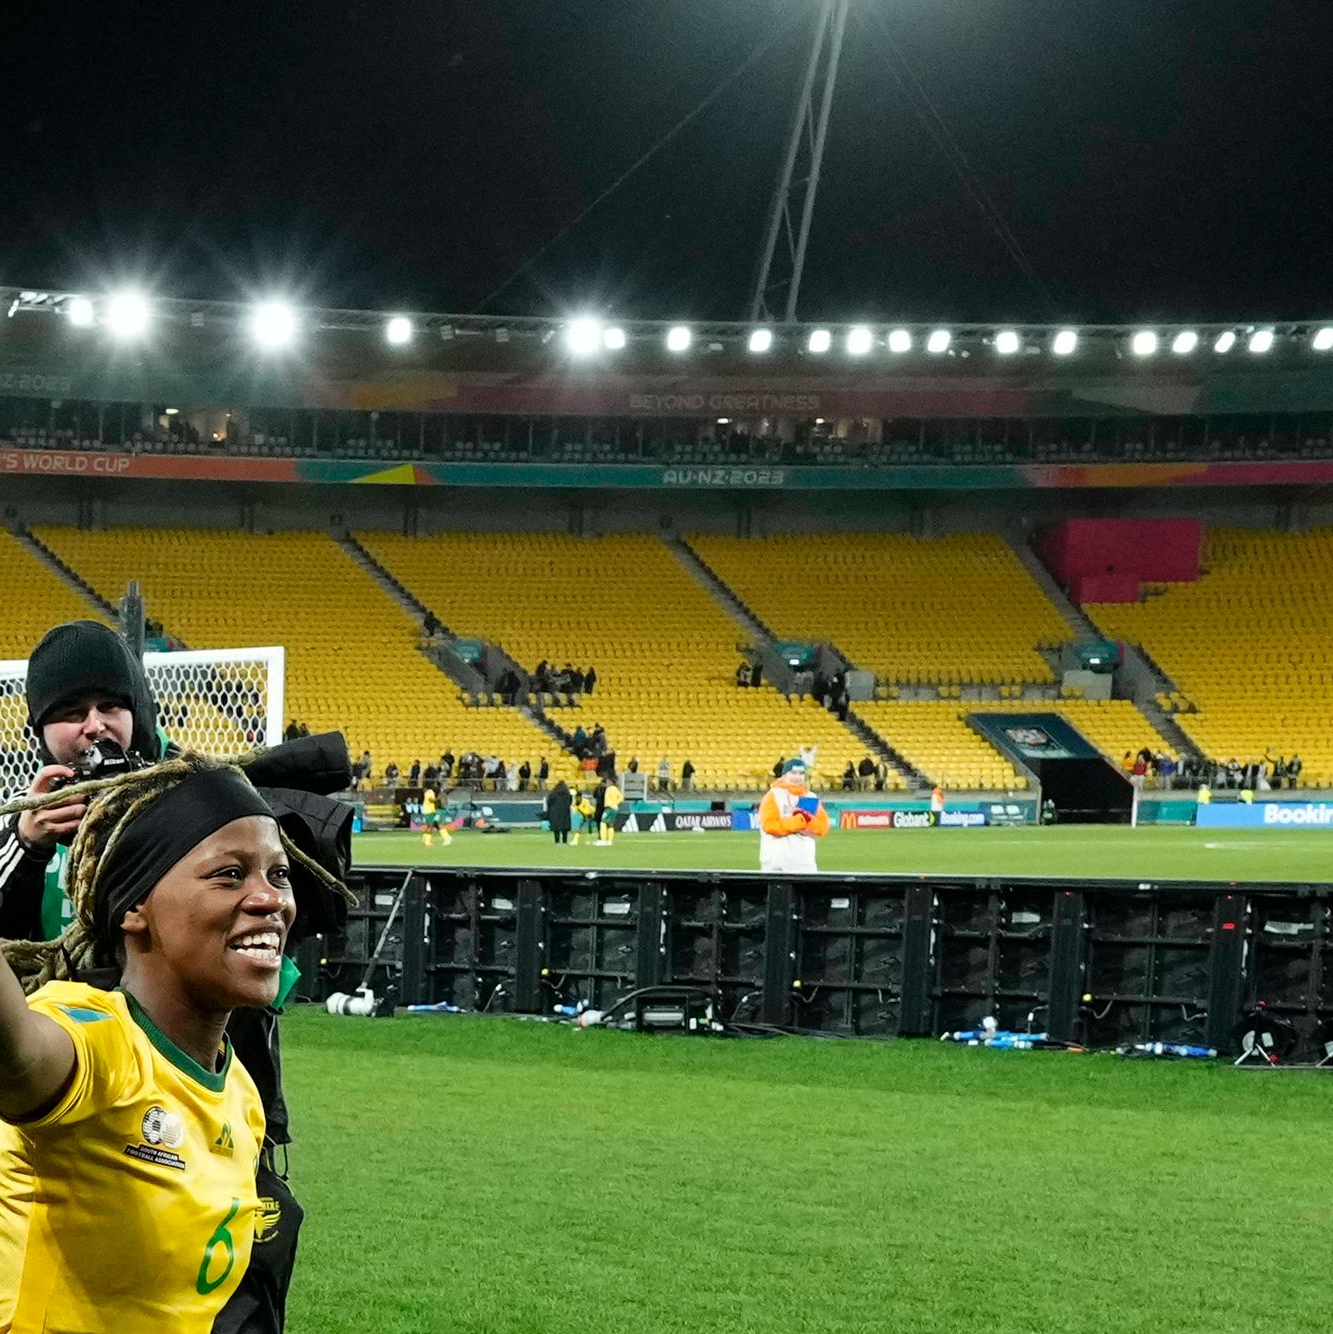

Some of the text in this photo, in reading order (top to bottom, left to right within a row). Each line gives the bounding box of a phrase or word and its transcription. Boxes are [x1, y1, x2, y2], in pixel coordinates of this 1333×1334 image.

[629, 394, 820, 410] BEYOND GREATNESS
[23, 455, 88, 472] WORLD
[92, 457, 130, 473] CUP
[675, 815, 732, 828] QATAR AIRWAYS
[893, 811, 930, 828] Globant
[126, 1147, 154, 1161] FOOTBALL
[196, 1195, 240, 1296] 6
